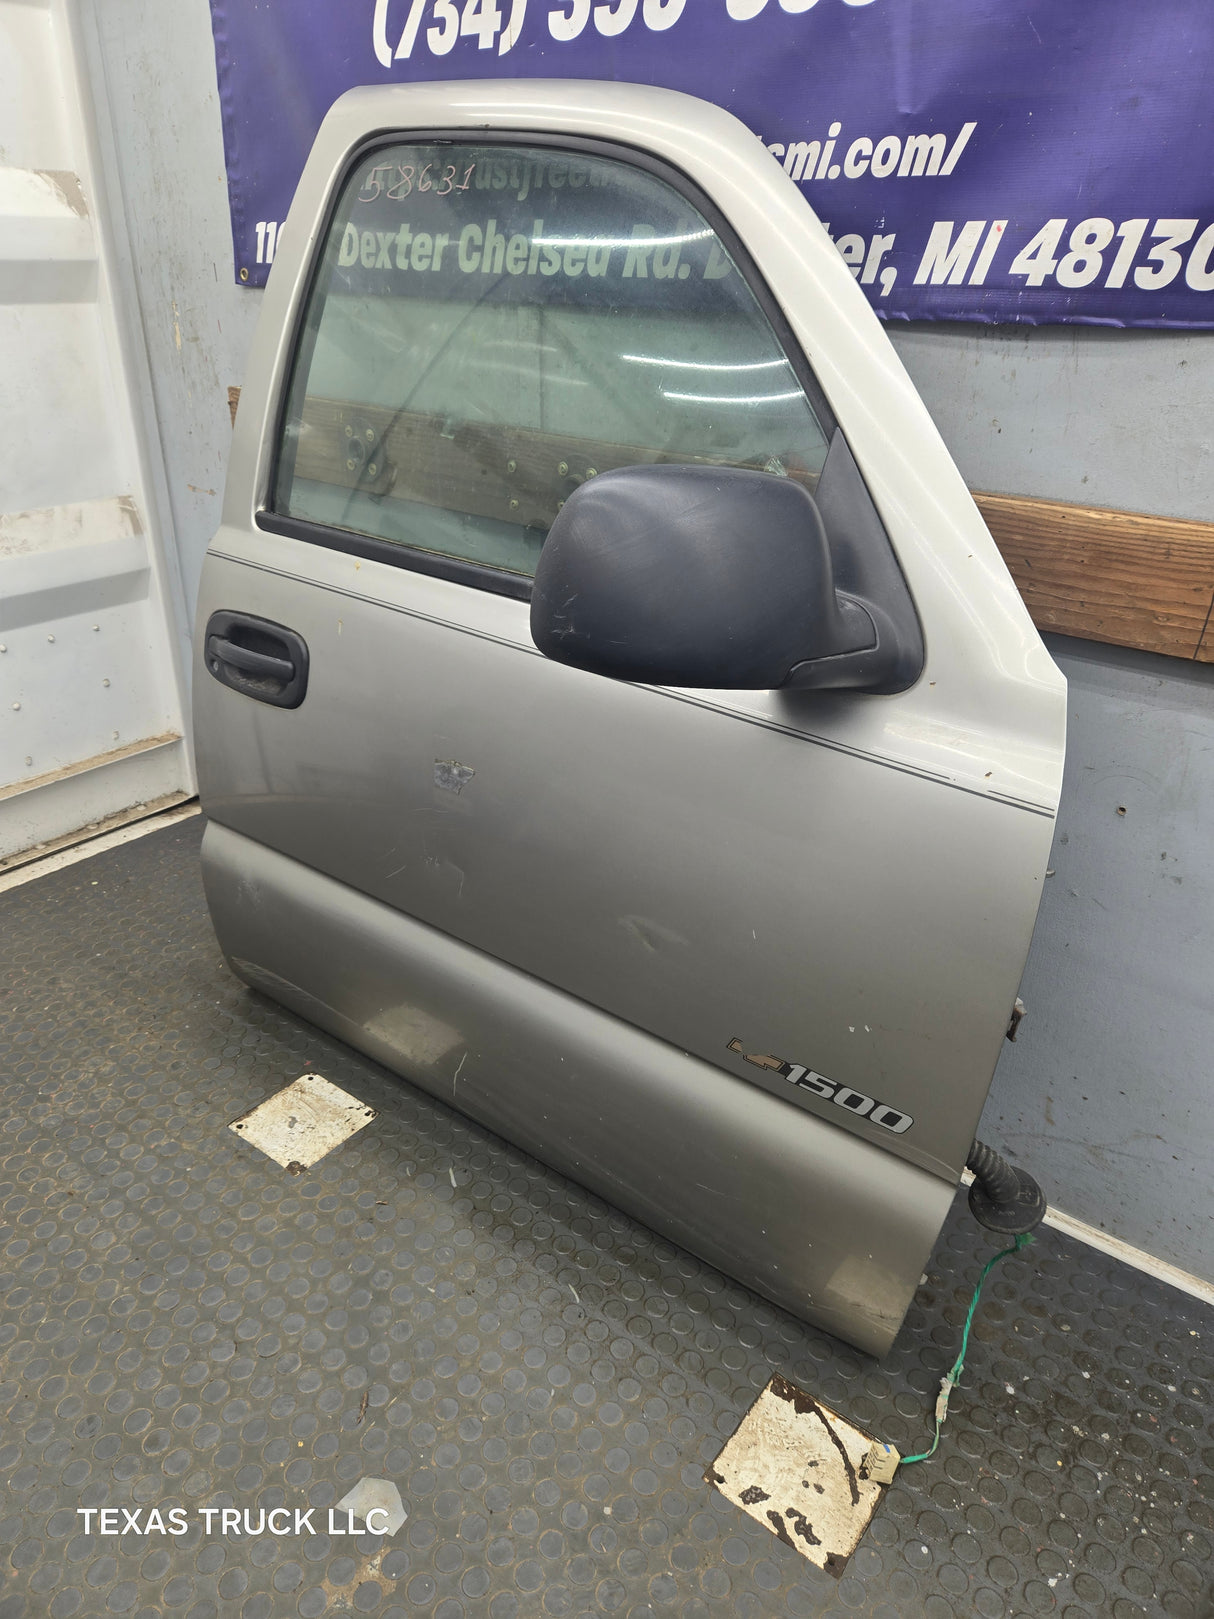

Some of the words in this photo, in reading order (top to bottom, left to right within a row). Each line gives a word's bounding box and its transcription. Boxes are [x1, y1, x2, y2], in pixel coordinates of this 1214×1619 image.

[358, 164, 476, 202] 58631
[255, 221, 287, 264] 11
[337, 222, 450, 272] Dexter
[913, 219, 1009, 286] MI
[784, 1062, 914, 1134] 1500
